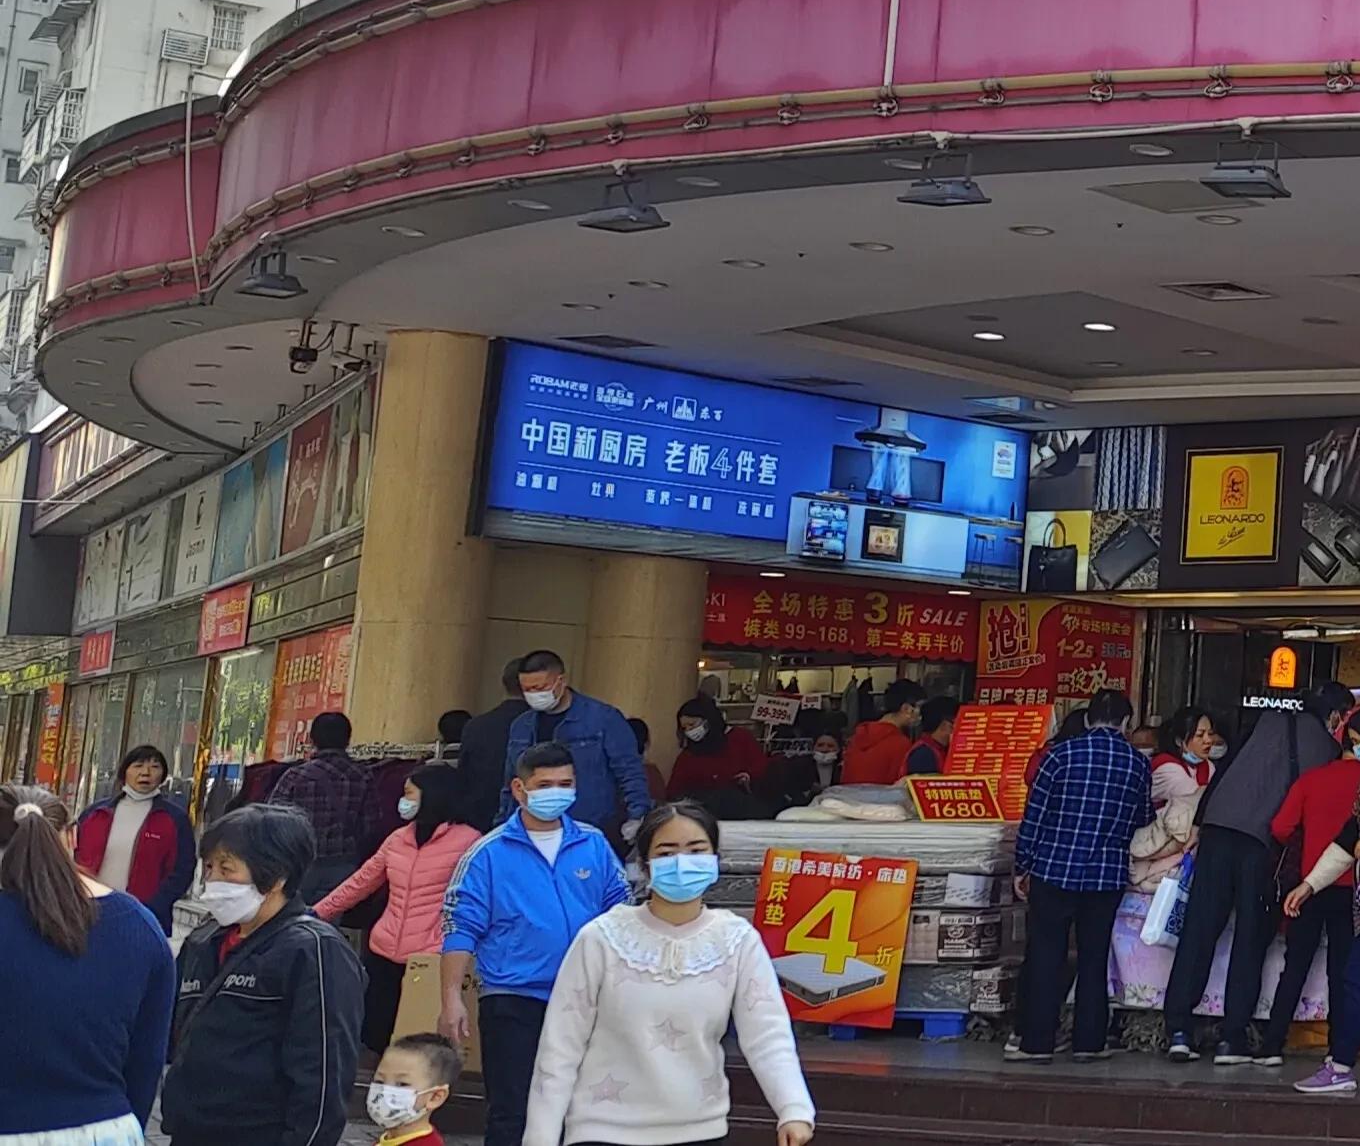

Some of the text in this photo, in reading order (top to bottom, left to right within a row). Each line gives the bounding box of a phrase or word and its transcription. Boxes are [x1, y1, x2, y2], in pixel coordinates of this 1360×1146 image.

[520, 417, 780, 487] 中国新厨房 老板4件套
[1199, 512, 1266, 525] LEONARDO
[918, 606, 970, 628] SALE
[762, 880, 791, 926] 床垫
[784, 888, 895, 975] 4 折
